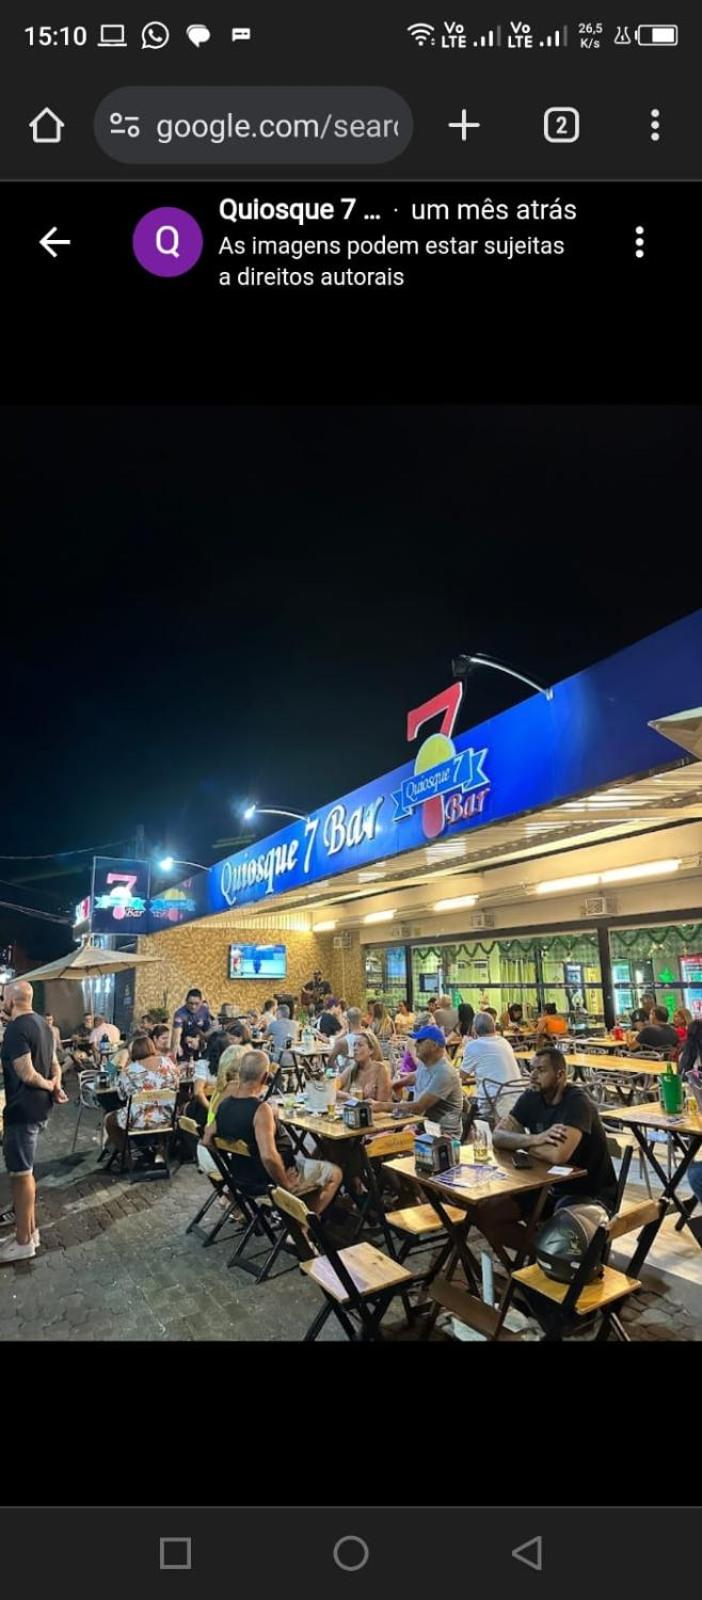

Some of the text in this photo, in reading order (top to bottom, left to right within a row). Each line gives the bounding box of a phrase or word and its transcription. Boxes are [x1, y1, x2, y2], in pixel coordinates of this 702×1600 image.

[406, 753, 465, 801] Quiosque 7
[446, 788, 490, 824] Bar
[220, 797, 384, 906] Quiosque 7 Bar
